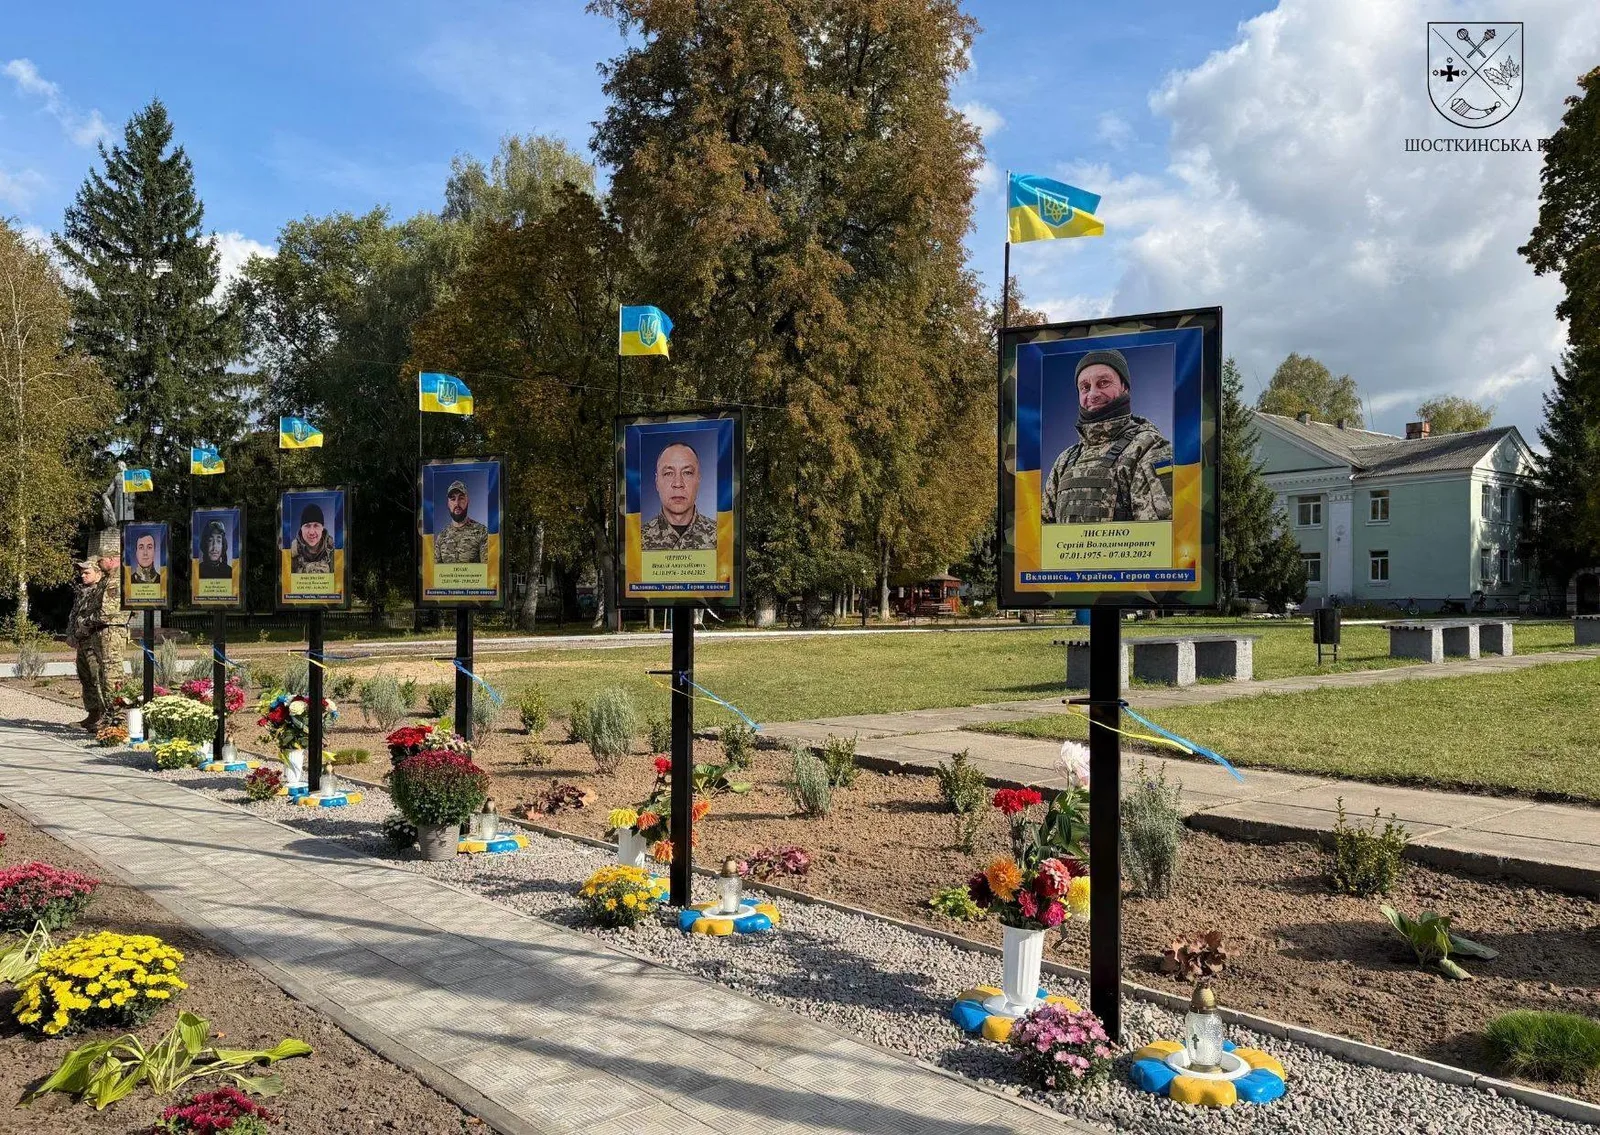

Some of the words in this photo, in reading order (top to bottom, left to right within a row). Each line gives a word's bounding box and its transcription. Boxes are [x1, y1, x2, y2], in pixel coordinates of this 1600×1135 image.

[1080, 528, 1130, 538] ЛИСЕНКО
[1056, 541, 1084, 551] Сергій
[1086, 540, 1156, 550] Володимирович
[1059, 551, 1101, 560] 07.01.1975
[1108, 550, 1152, 559] 07.03.2024
[1025, 572, 1072, 582] Вклонись,
[1076, 572, 1116, 582] Україно,
[1120, 571, 1150, 581] Герою
